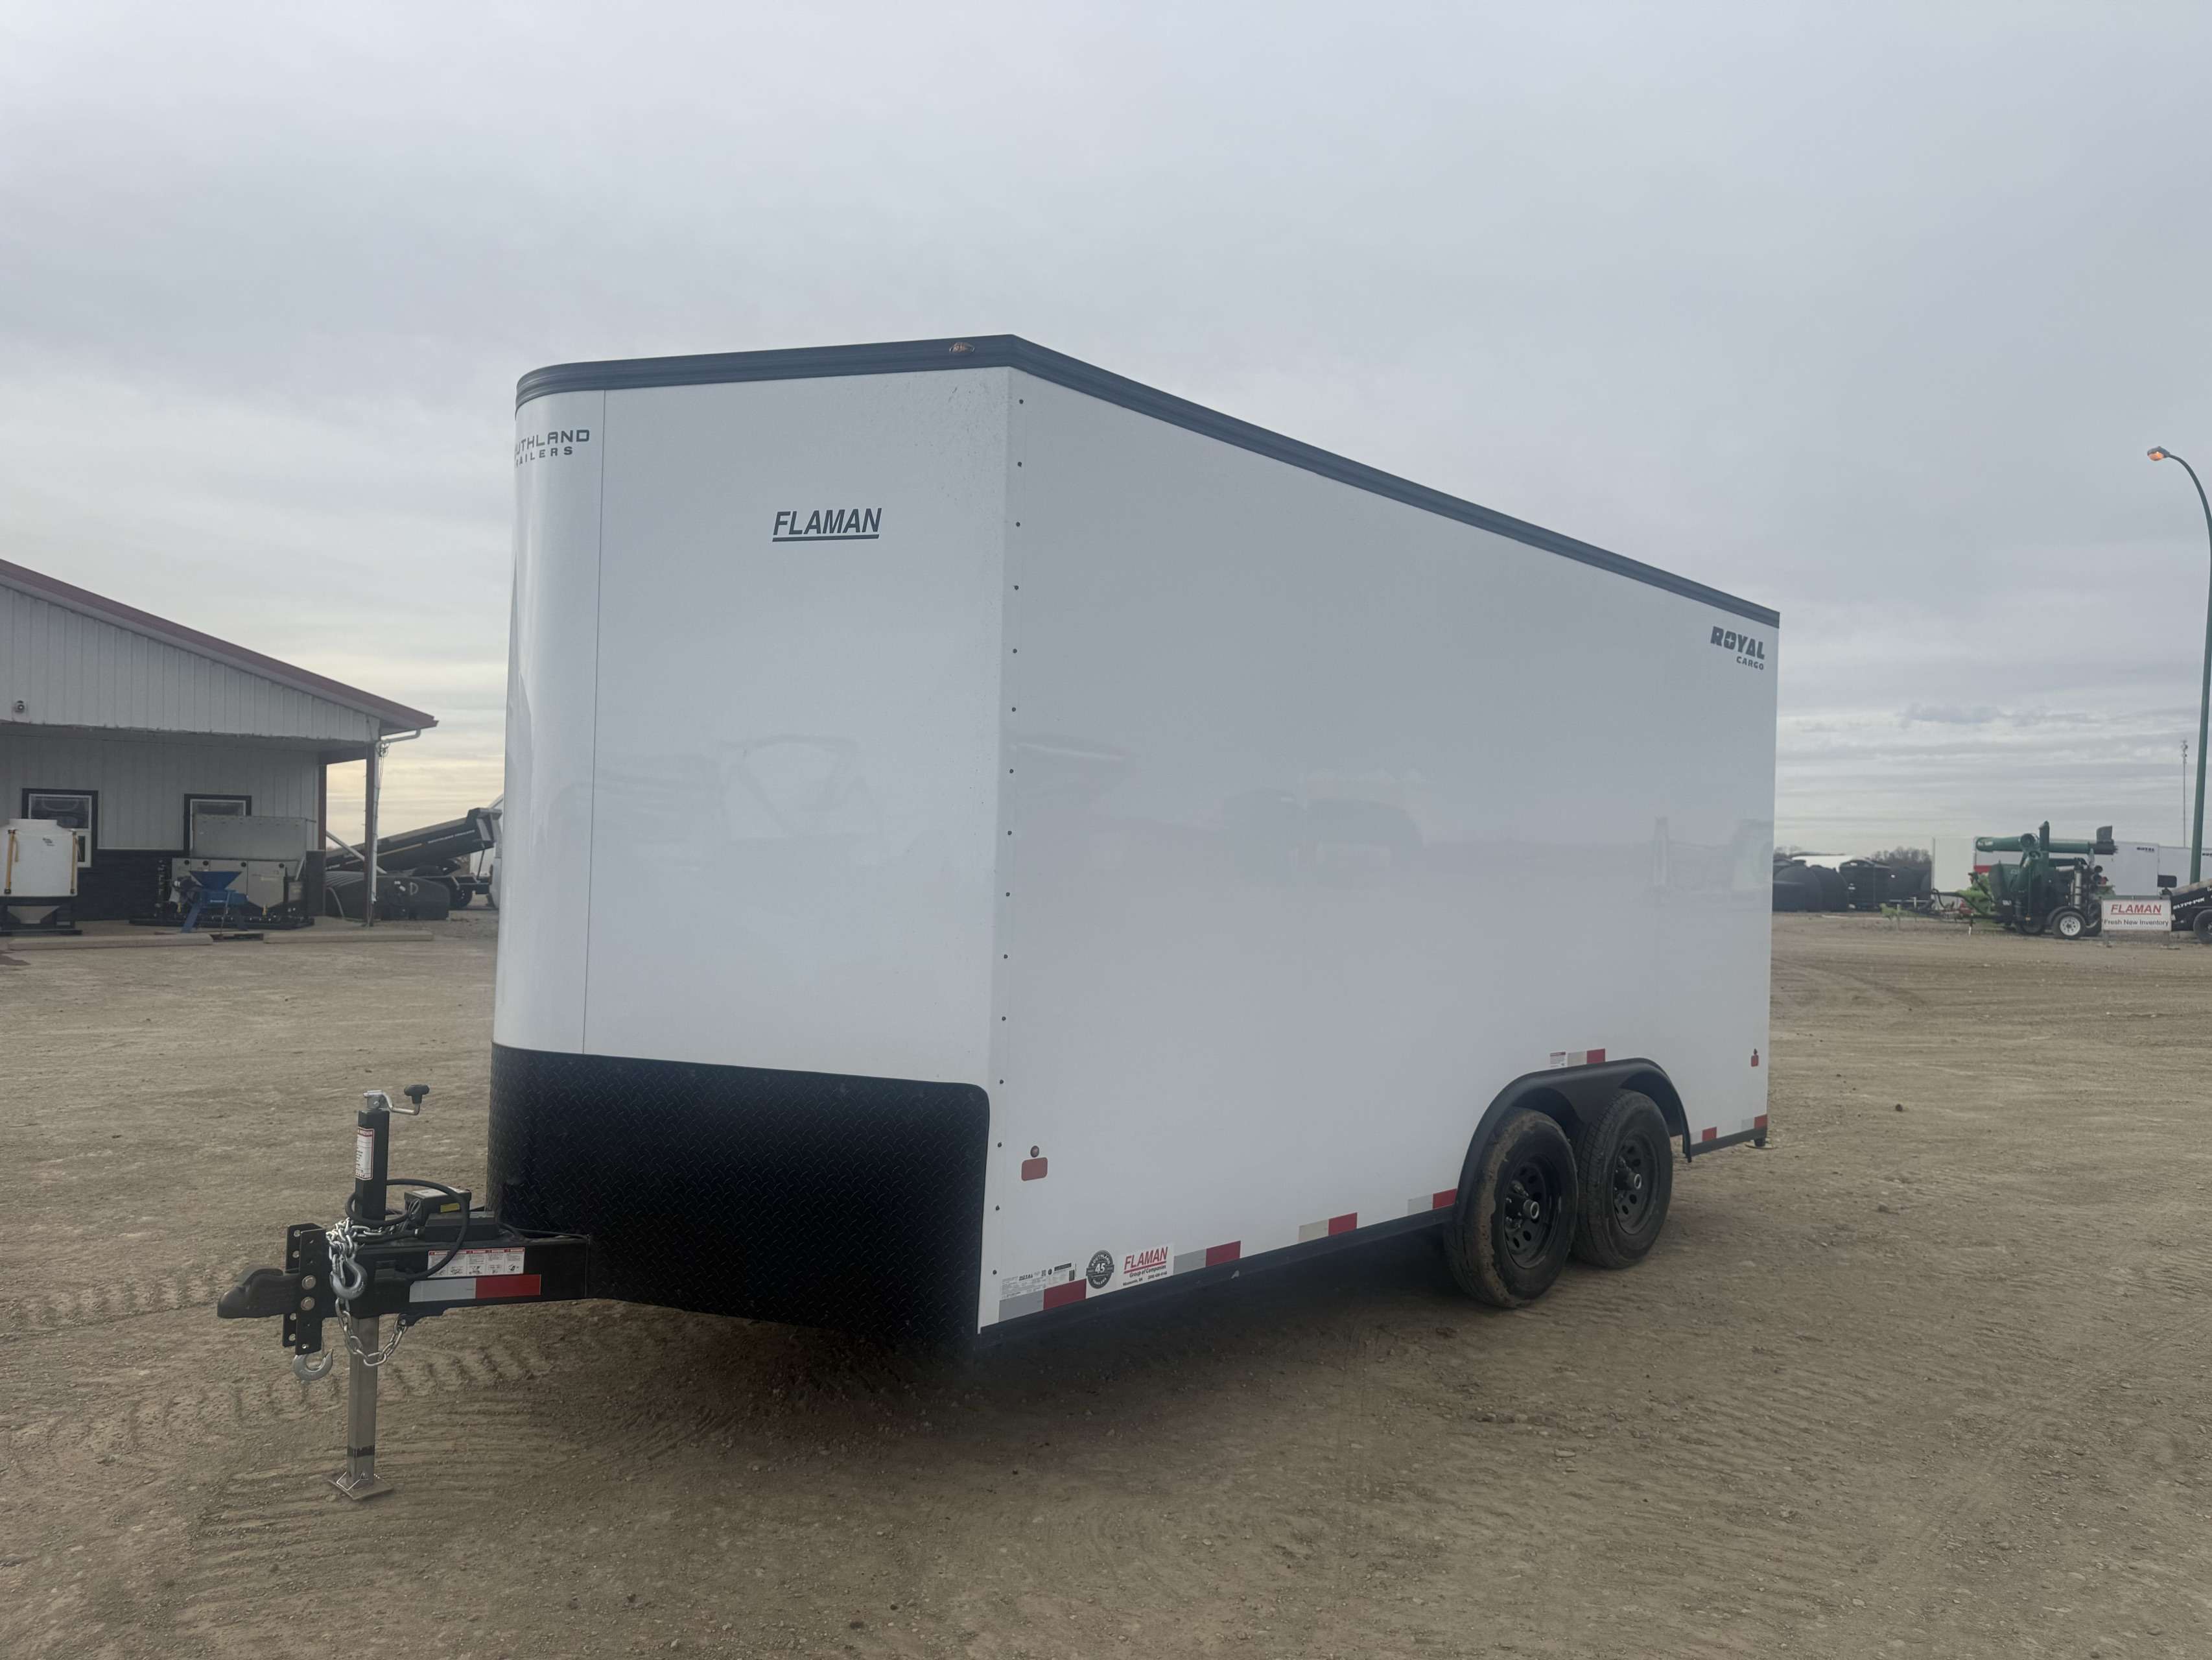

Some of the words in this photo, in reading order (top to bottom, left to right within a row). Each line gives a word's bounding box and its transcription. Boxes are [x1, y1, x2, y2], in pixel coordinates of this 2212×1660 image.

[517, 429, 590, 455] UTHLAND
[516, 445, 573, 466] AILERS
[773, 508, 882, 536] FLAMAN
[1710, 626, 1765, 659] ROYAL
[1736, 656, 1764, 670] CARGO
[2111, 904, 2161, 914] FLAMAN
[1095, 1263, 1105, 1274] 45
[1124, 1246, 1168, 1270] FLAMAN
